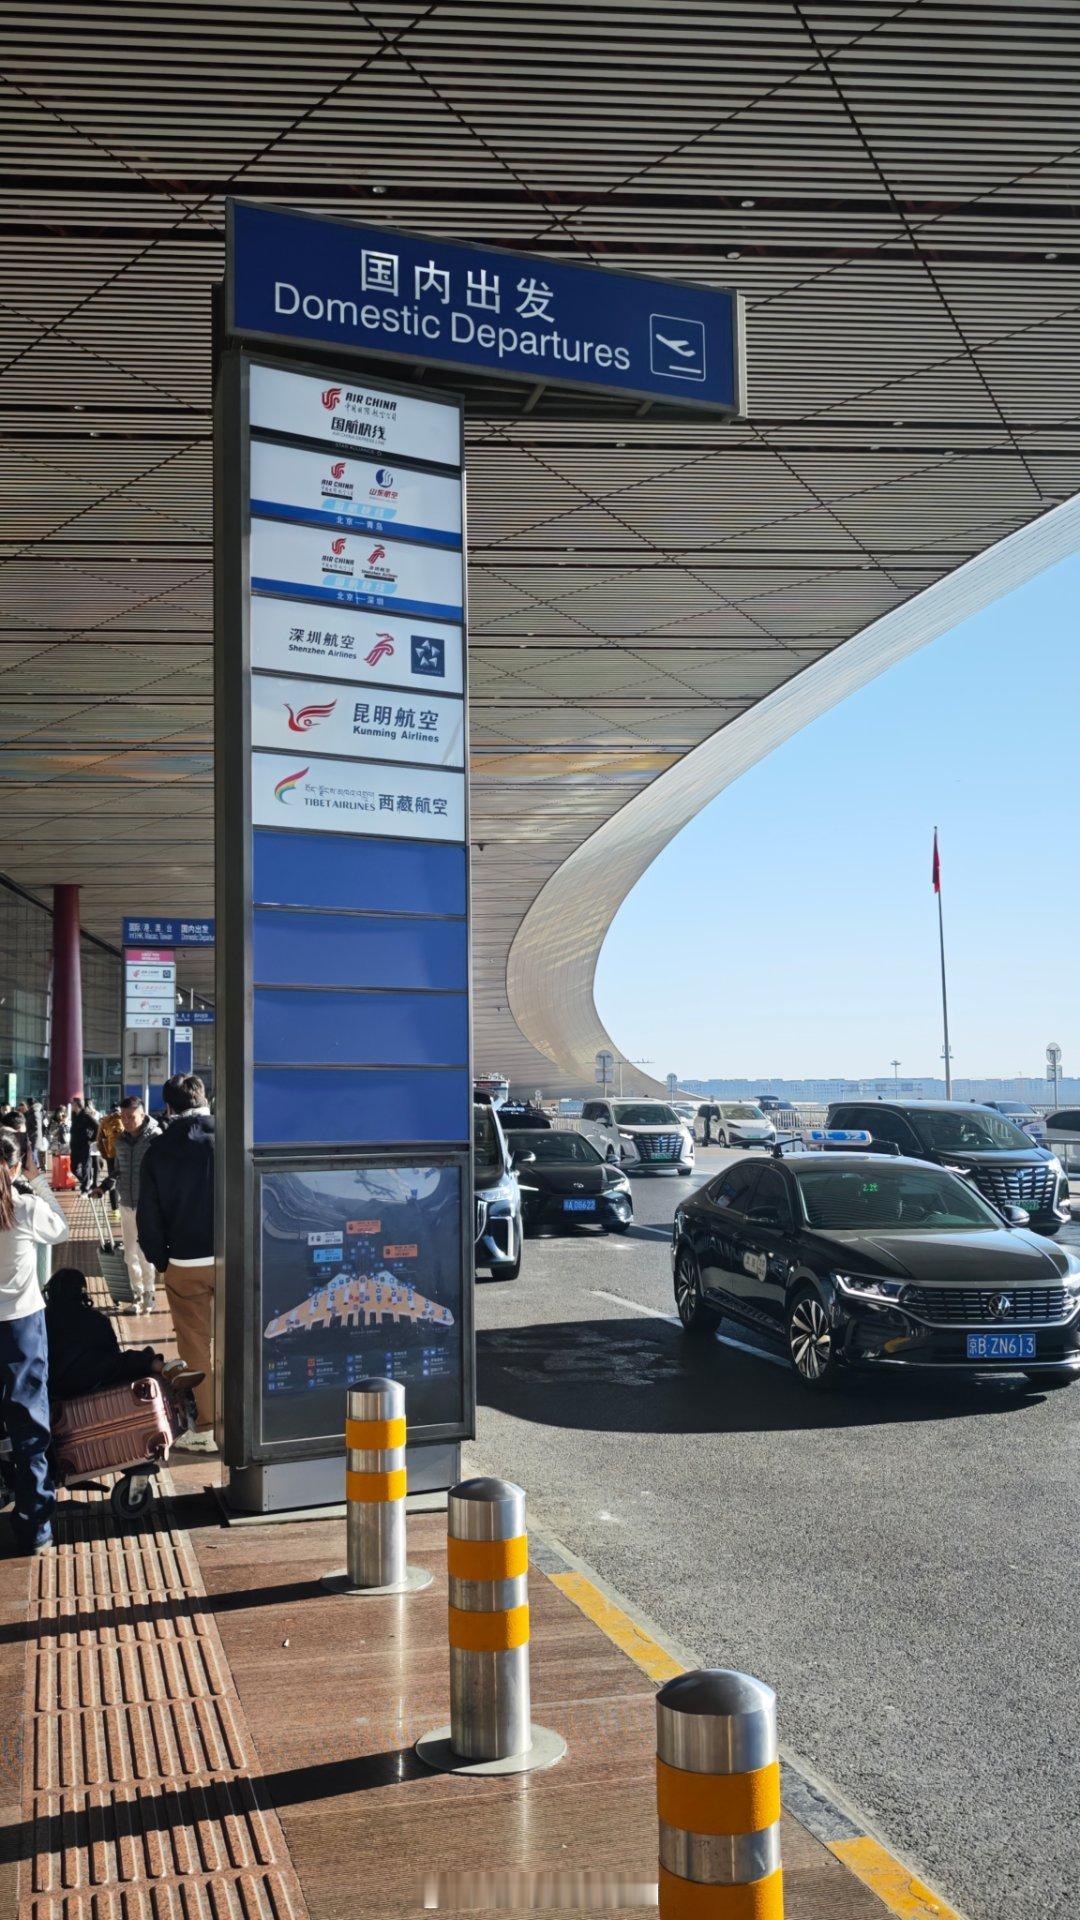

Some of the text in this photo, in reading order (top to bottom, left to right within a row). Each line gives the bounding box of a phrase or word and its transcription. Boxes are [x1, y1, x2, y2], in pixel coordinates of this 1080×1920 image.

[360, 249, 555, 323] 国内出发
[274, 282, 630, 370] Domestic Departures
[345, 392, 397, 411] AIR CHINA
[331, 416, 386, 440] 国航快线
[289, 627, 355, 650] 深圳航空
[288, 644, 357, 660] Shenzhen Airlines
[353, 703, 439, 731] 昆明航空
[353, 725, 439, 743] Kunming Airlines
[304, 797, 376, 811] TIBET AIRLINES
[378, 793, 448, 816] 西藏航空
